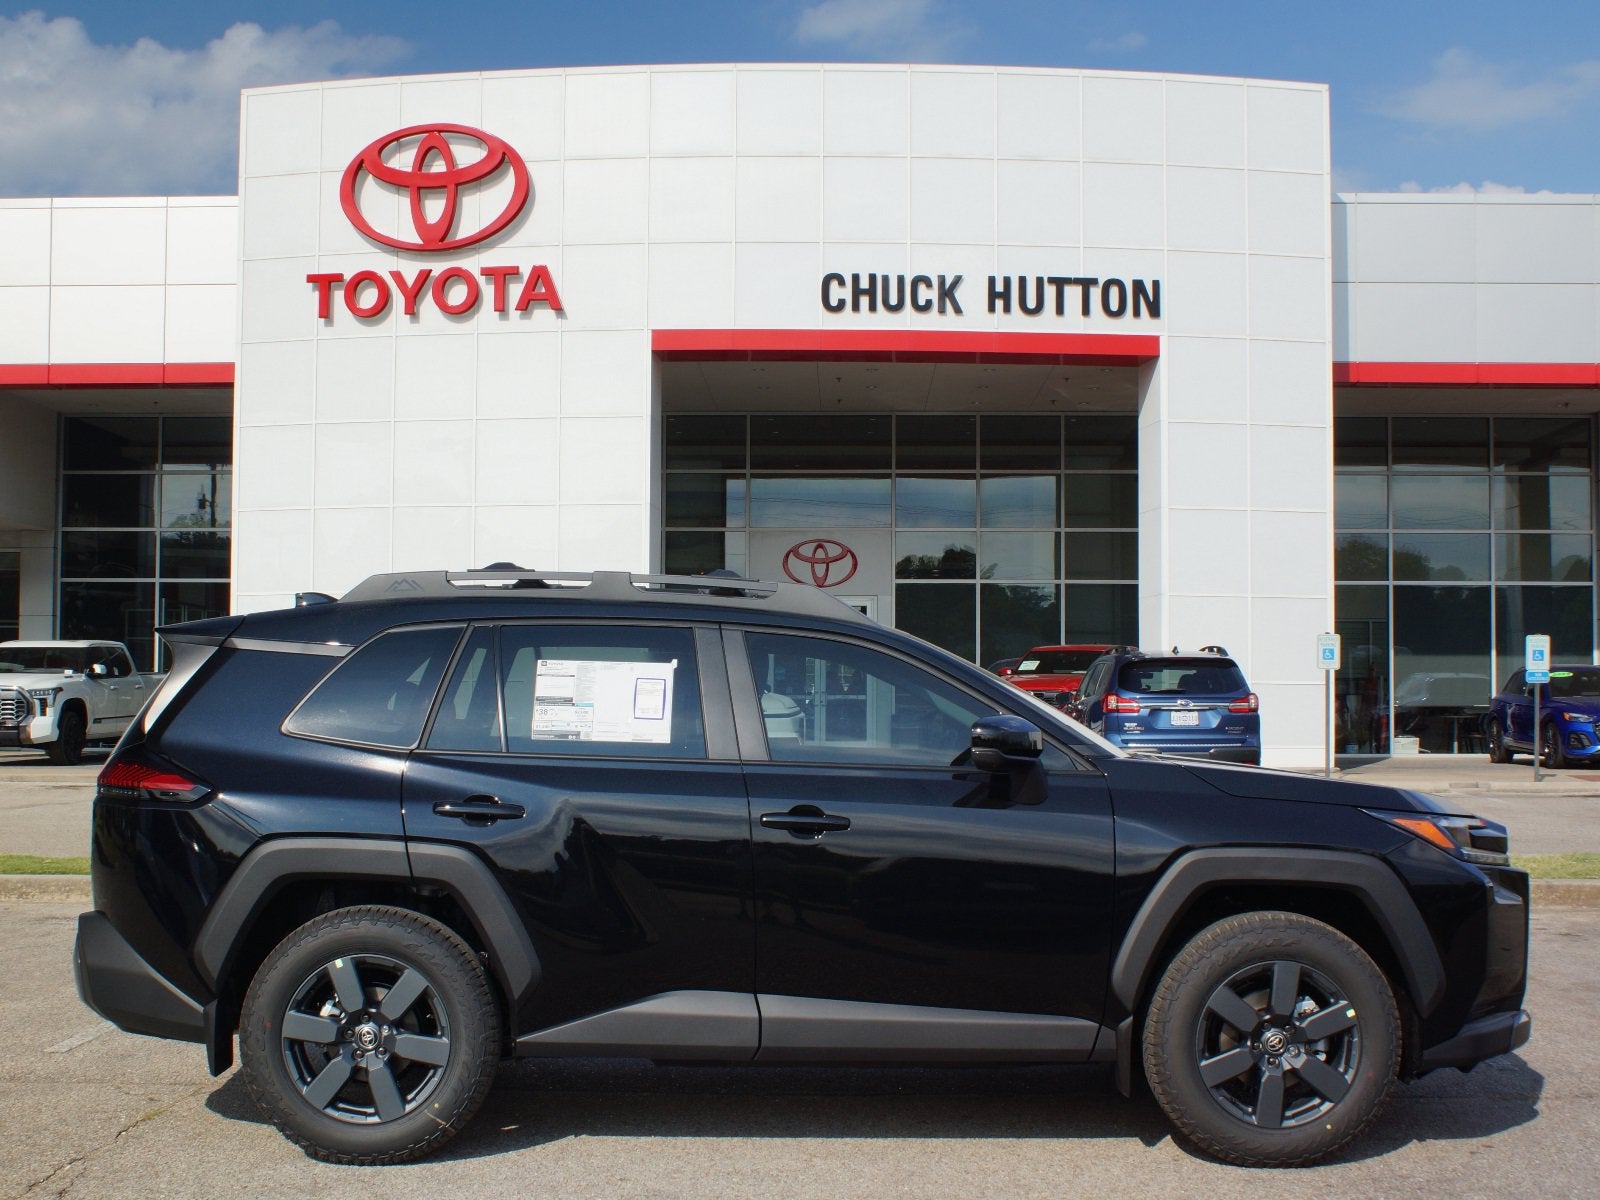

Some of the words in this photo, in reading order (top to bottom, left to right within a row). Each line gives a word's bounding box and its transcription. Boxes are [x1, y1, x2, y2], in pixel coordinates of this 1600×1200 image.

[306, 265, 564, 319] TOYOTA
[821, 273, 963, 314] CHUCK
[988, 275, 1161, 318] HUTTON
